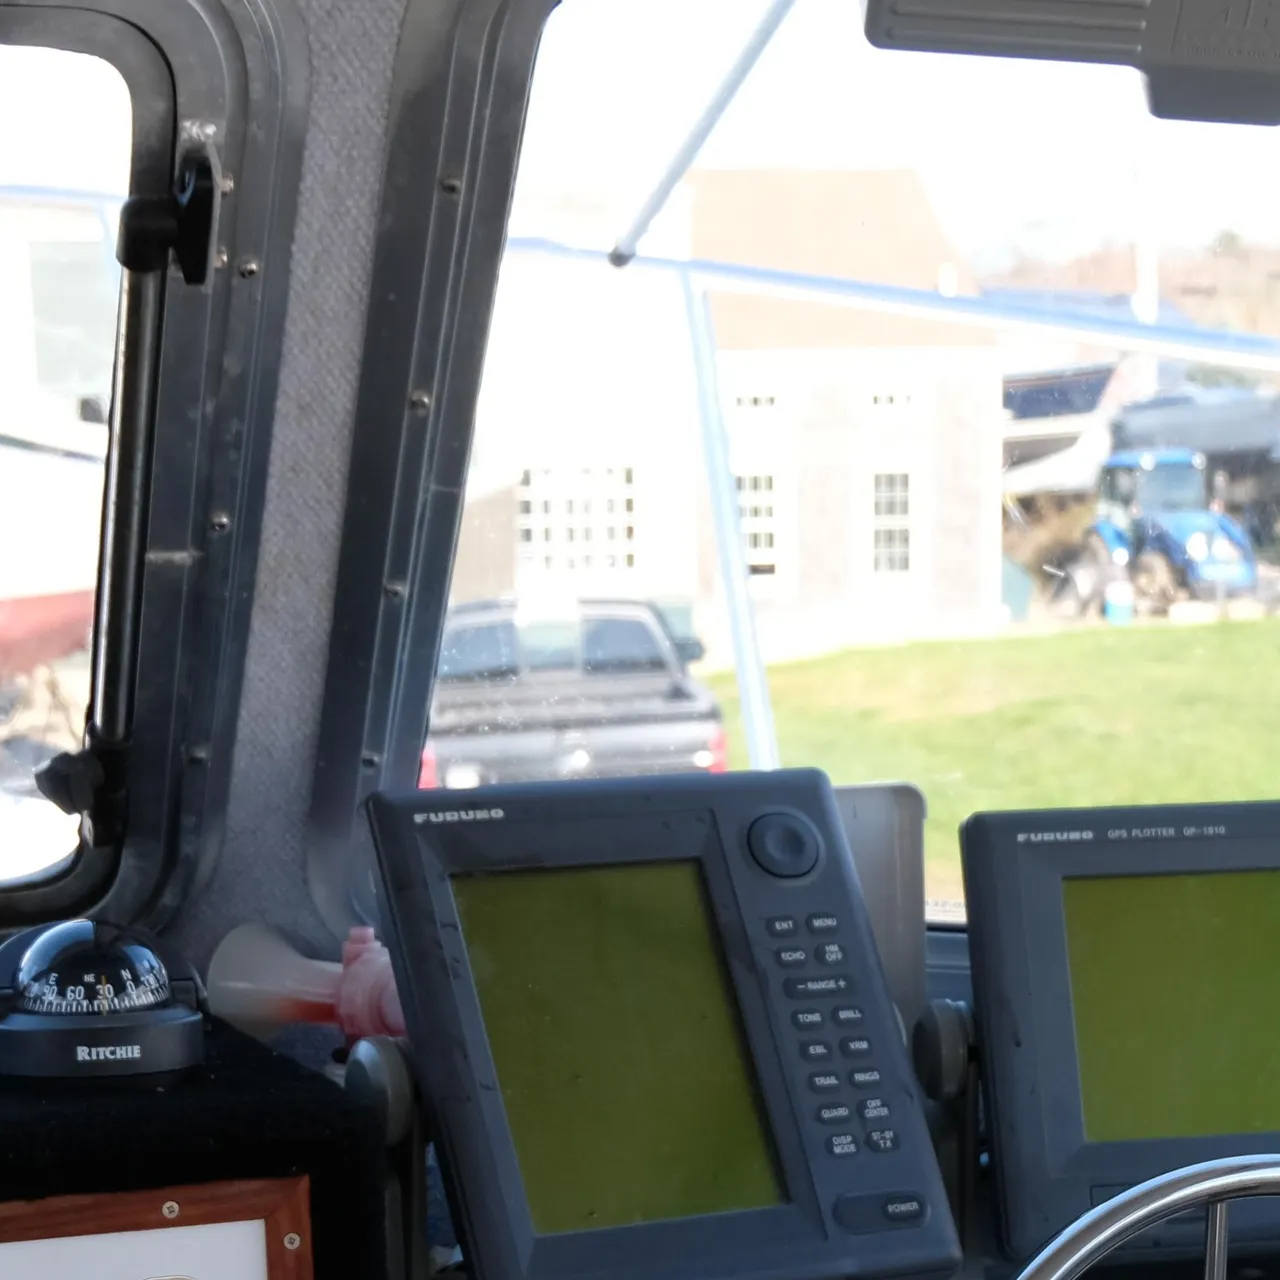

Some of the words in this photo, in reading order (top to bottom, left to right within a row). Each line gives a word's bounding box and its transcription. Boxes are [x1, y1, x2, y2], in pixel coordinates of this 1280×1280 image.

[413, 808, 504, 823] FURUNO
[1017, 831, 1093, 842] FURUNO
[1131, 827, 1175, 838] PLOTTER
[67, 985, 84, 1000] 60
